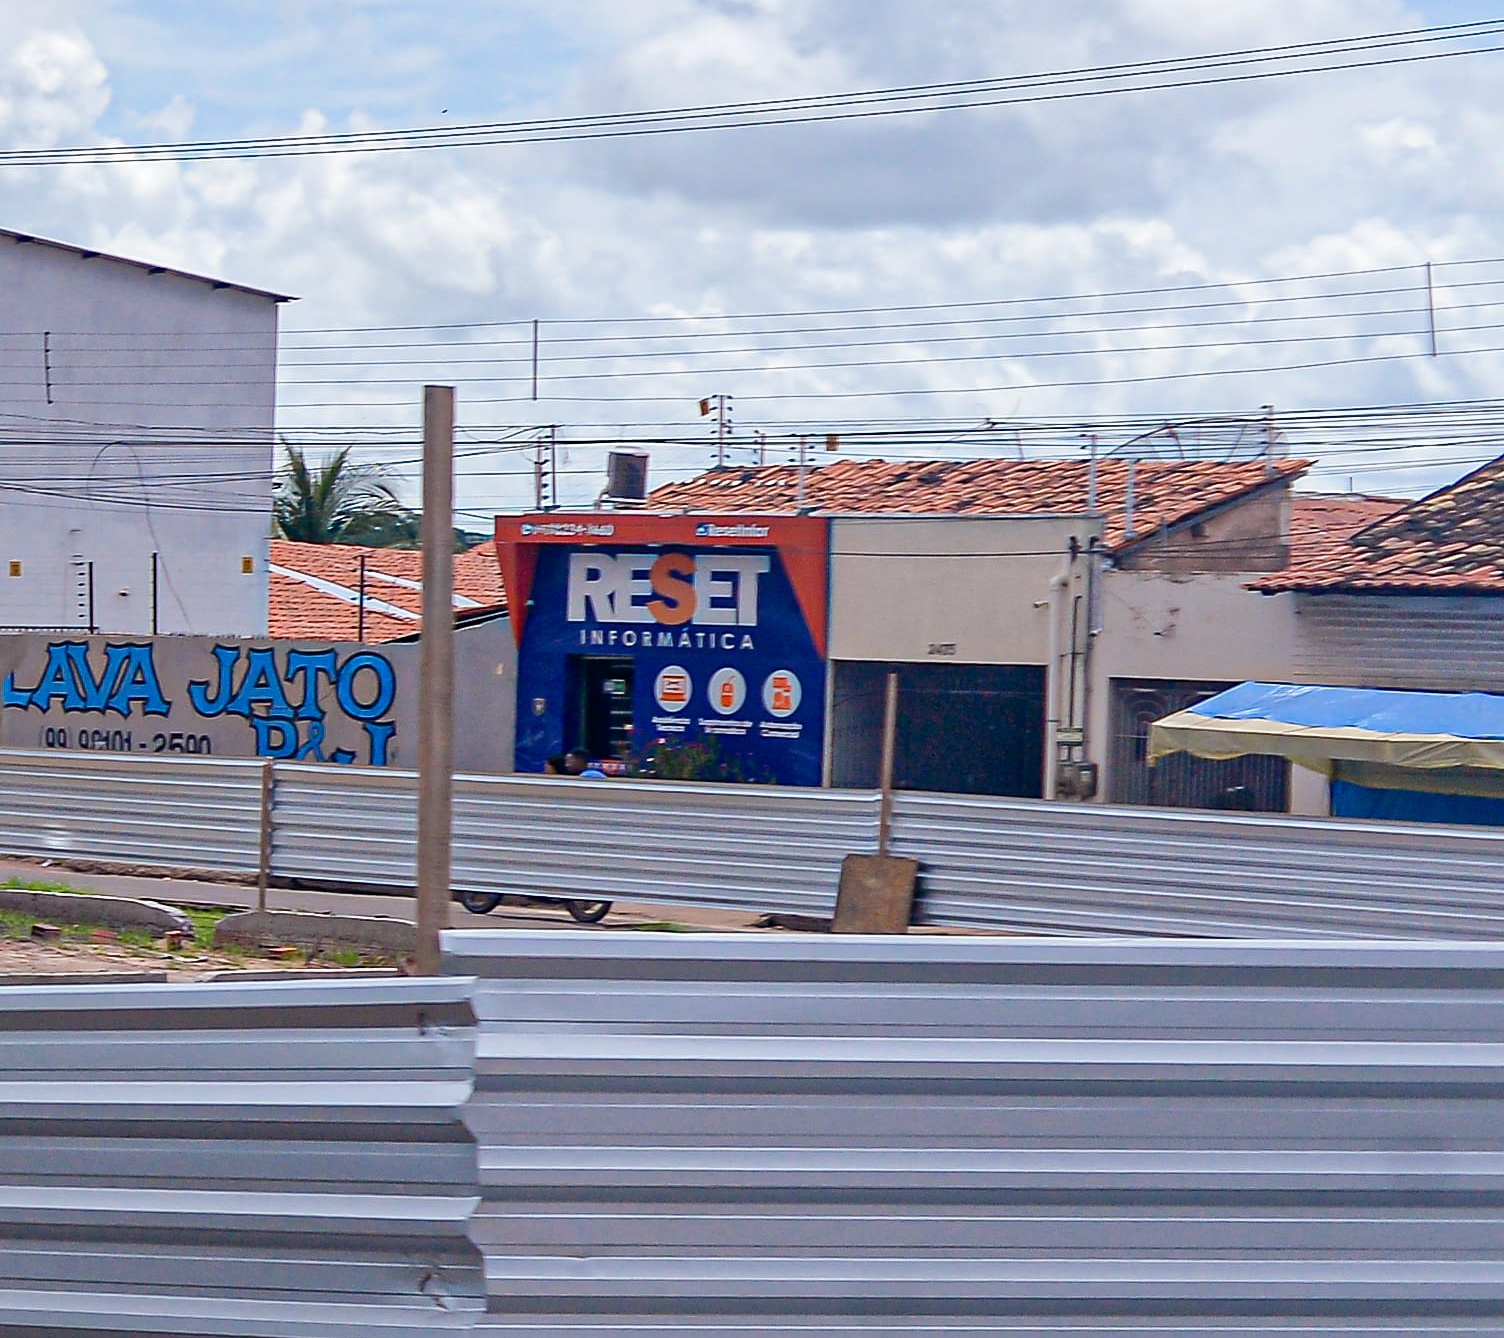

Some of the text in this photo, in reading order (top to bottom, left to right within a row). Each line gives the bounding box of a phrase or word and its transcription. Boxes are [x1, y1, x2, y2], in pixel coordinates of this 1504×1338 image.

[566, 552, 771, 626] RESET
[579, 627, 755, 650] INFORMÁTICA
[1, 640, 396, 722] LAVA JATO
